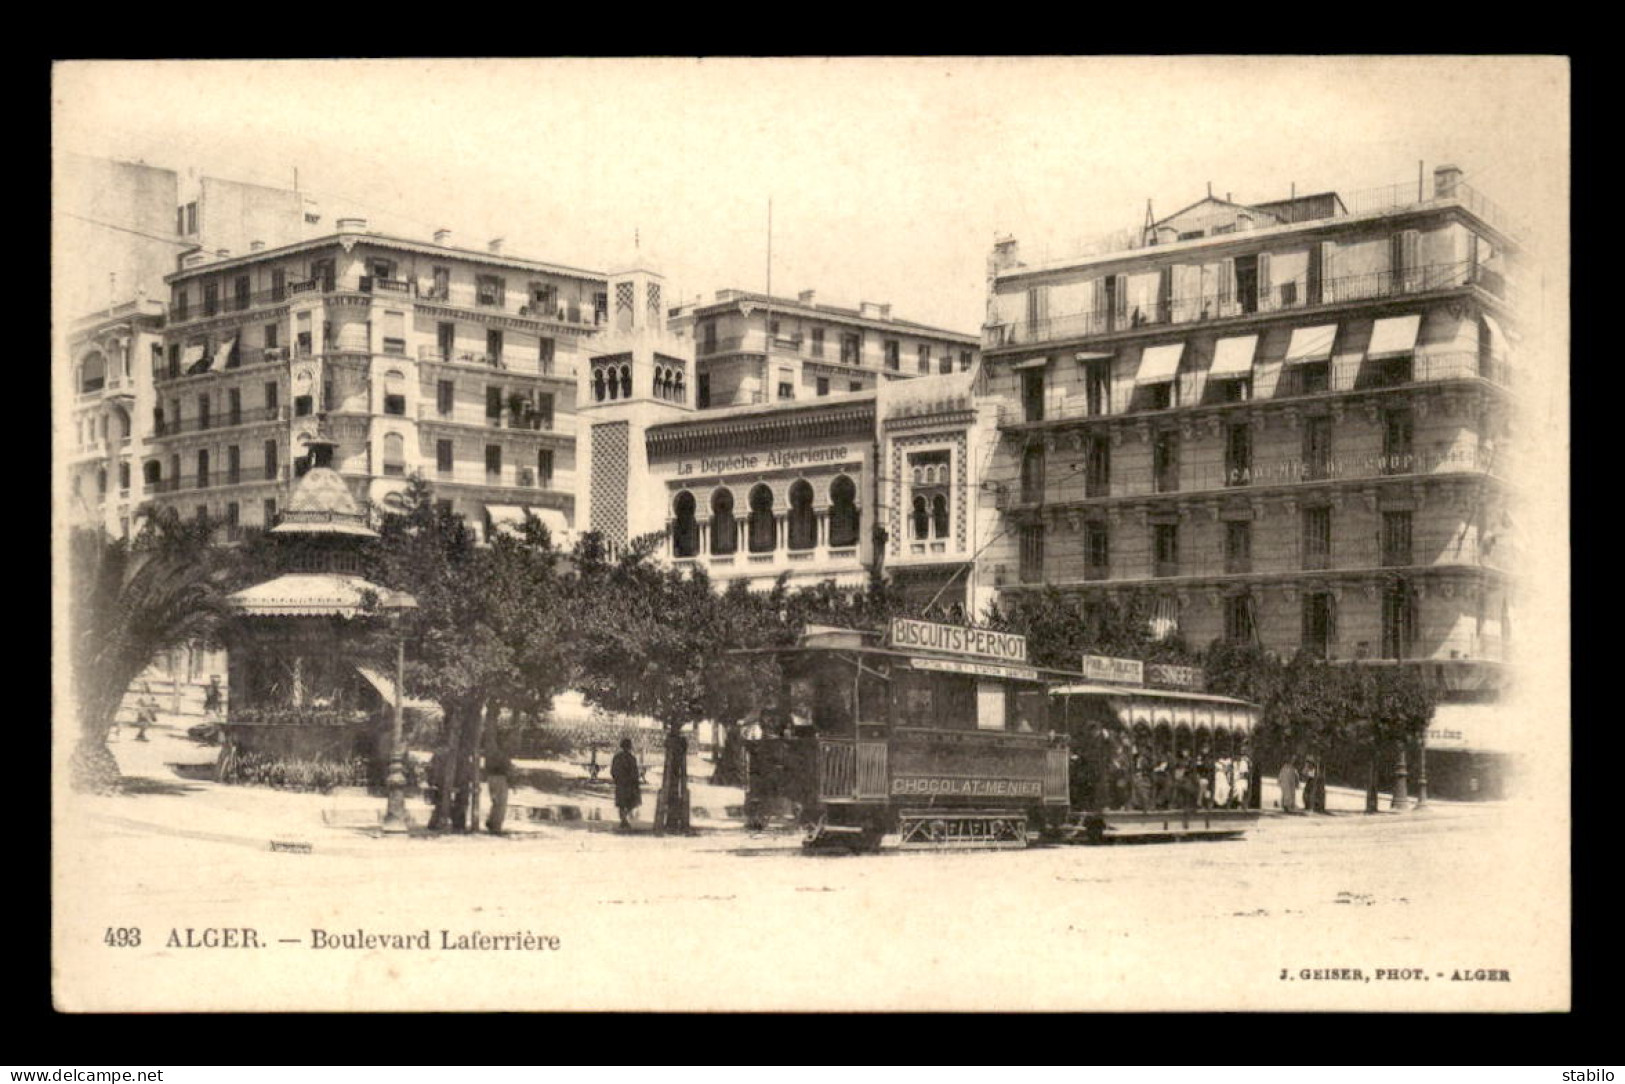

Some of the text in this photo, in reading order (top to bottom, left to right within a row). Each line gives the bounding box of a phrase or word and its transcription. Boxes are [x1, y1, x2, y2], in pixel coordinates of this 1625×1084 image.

[677, 445, 849, 475] La Dépêche Algérienne
[895, 618, 1025, 658] BISCUITS PERNOT
